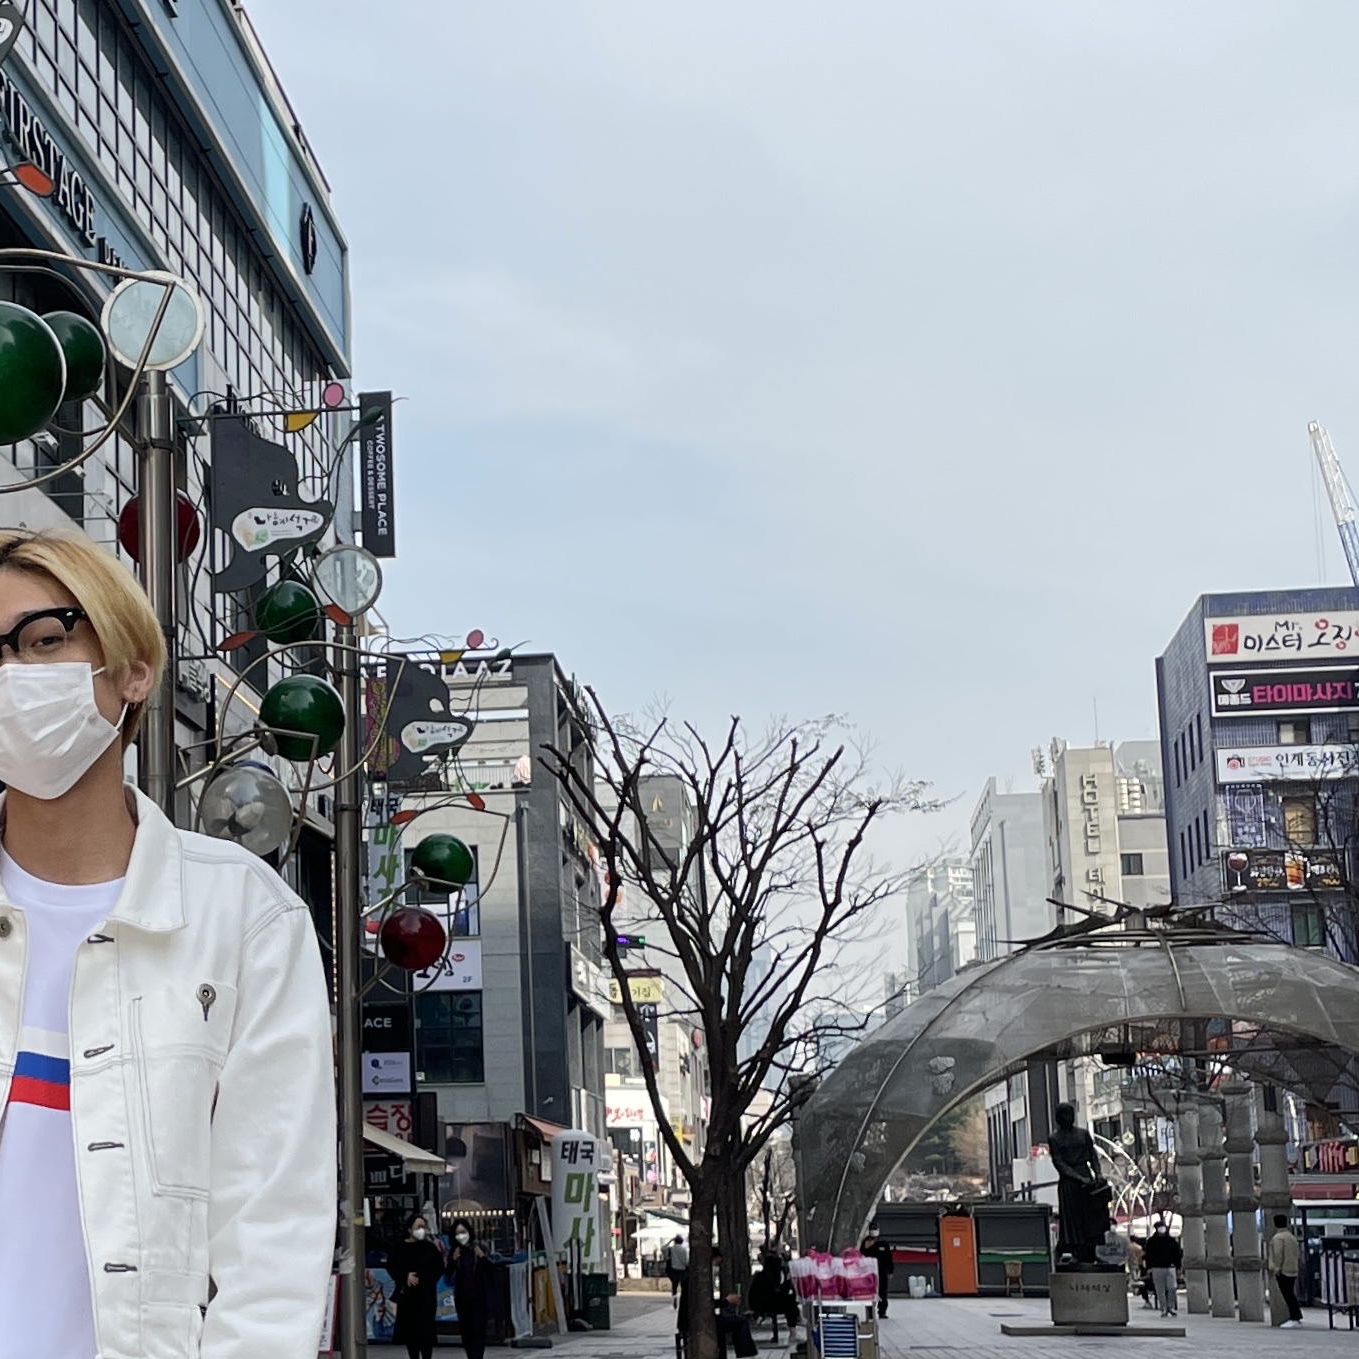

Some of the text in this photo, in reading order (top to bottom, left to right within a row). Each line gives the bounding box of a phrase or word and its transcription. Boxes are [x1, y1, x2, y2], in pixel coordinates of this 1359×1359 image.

[374, 424, 387, 490] TWOSOME
[376, 494, 388, 536] PLACE
[1243, 618, 1359, 653] 미스터 오징
[1253, 681, 1353, 704] 타이마사지
[1081, 774, 1102, 853] HOTEL
[363, 1016, 393, 1029] ACE
[560, 1140, 595, 1164] 태국
[562, 1172, 595, 1272] 마사
